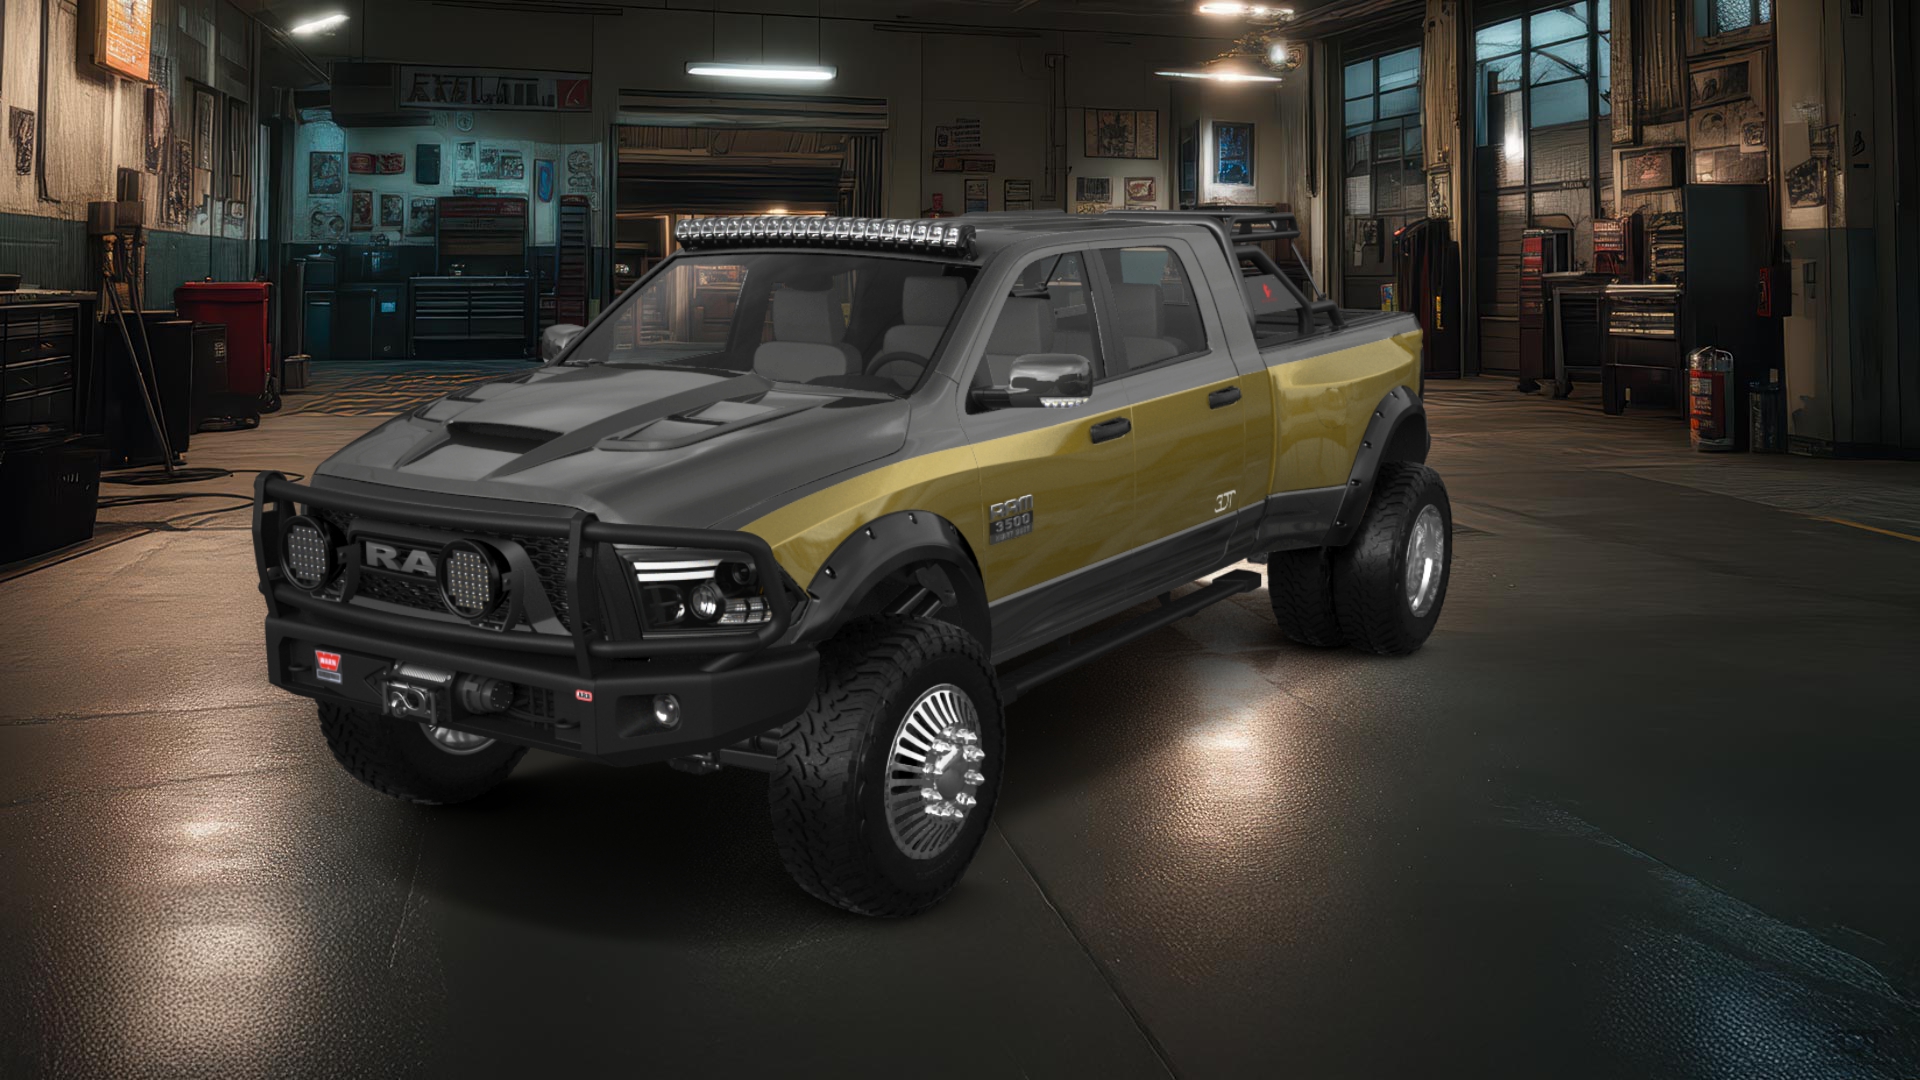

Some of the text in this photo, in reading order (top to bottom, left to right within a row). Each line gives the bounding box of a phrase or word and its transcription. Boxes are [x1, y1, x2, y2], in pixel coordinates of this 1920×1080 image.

[990, 494, 1033, 520] RAM
[995, 513, 1030, 532] 3500
[365, 541, 437, 577] RA
